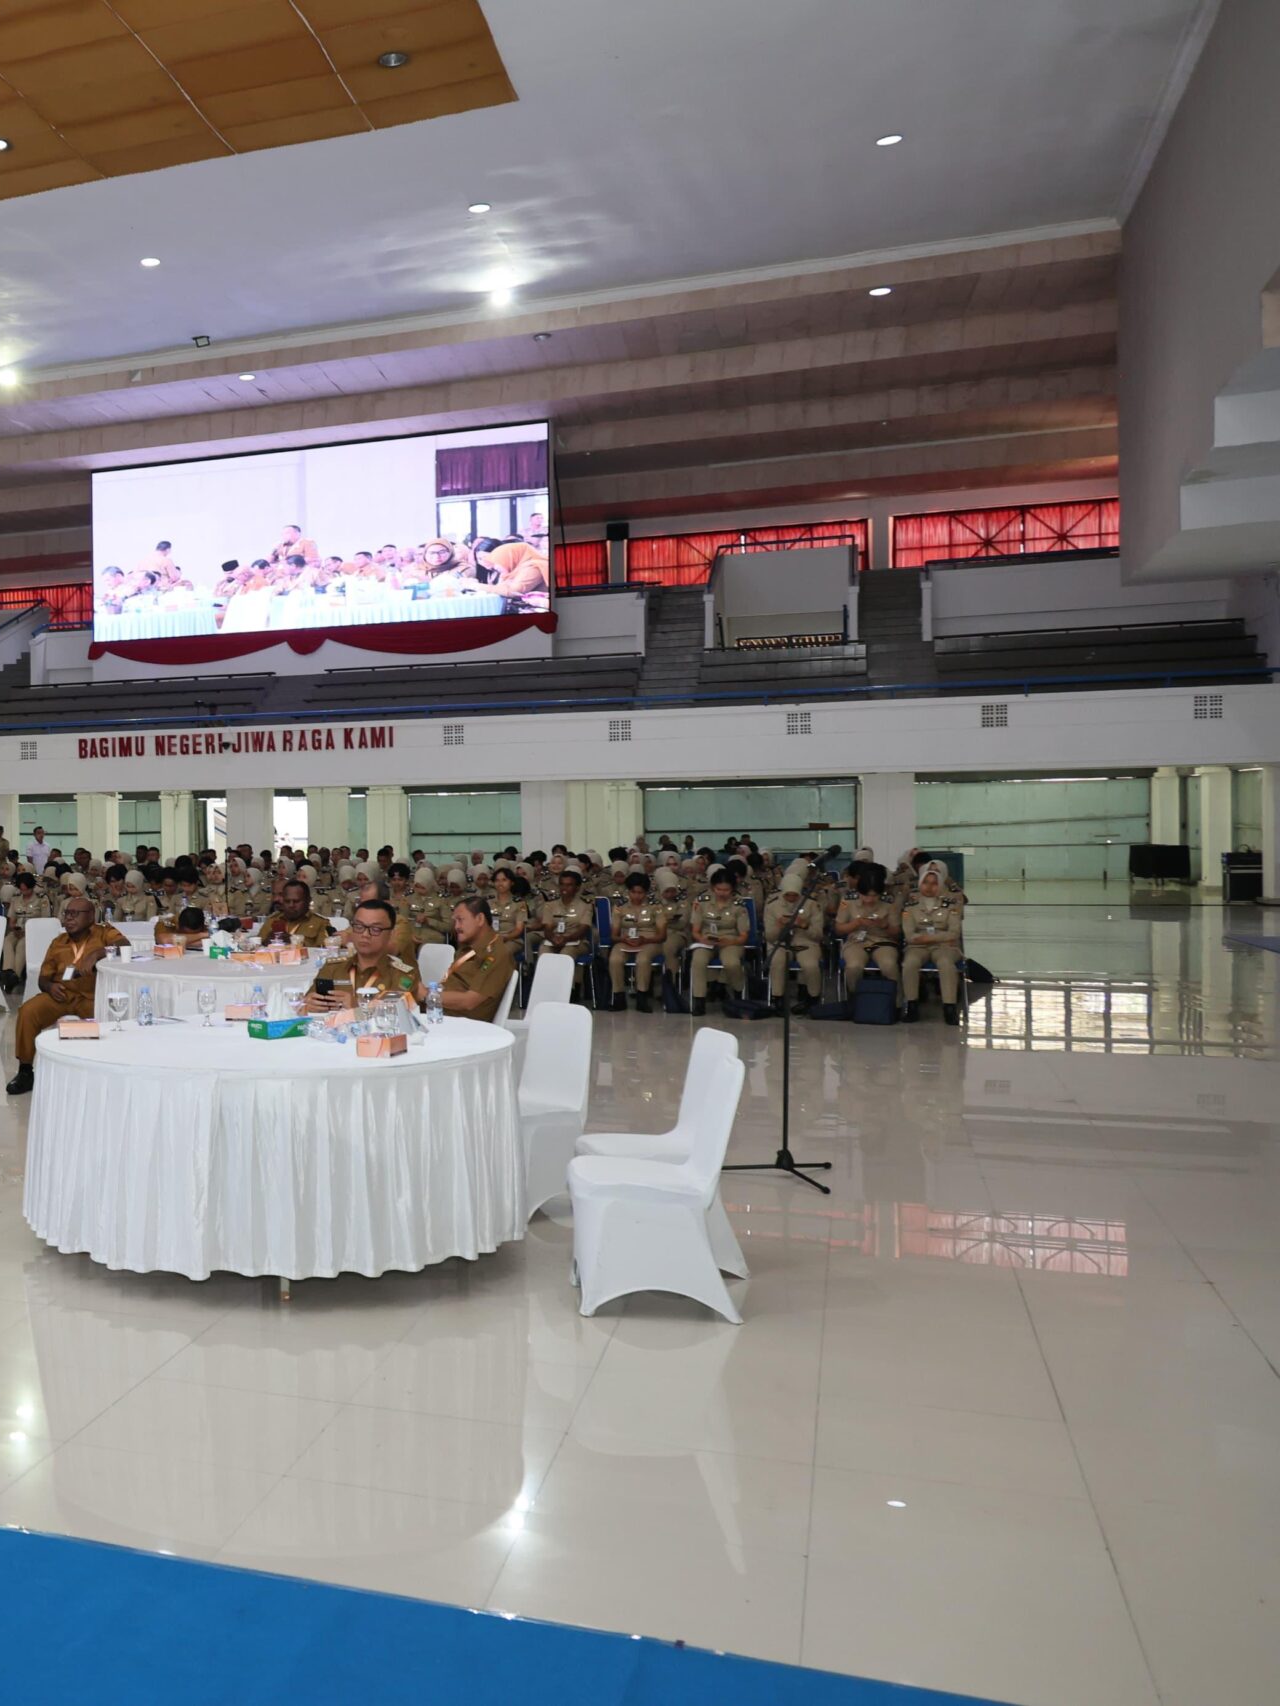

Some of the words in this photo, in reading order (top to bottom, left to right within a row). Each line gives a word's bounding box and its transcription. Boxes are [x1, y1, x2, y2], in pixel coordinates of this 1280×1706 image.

[78, 735, 145, 759] BAGIMU
[155, 732, 223, 755] NEGERI
[231, 730, 276, 753] JIWA
[282, 728, 335, 752] RAGA
[343, 726, 394, 750] KAMI
